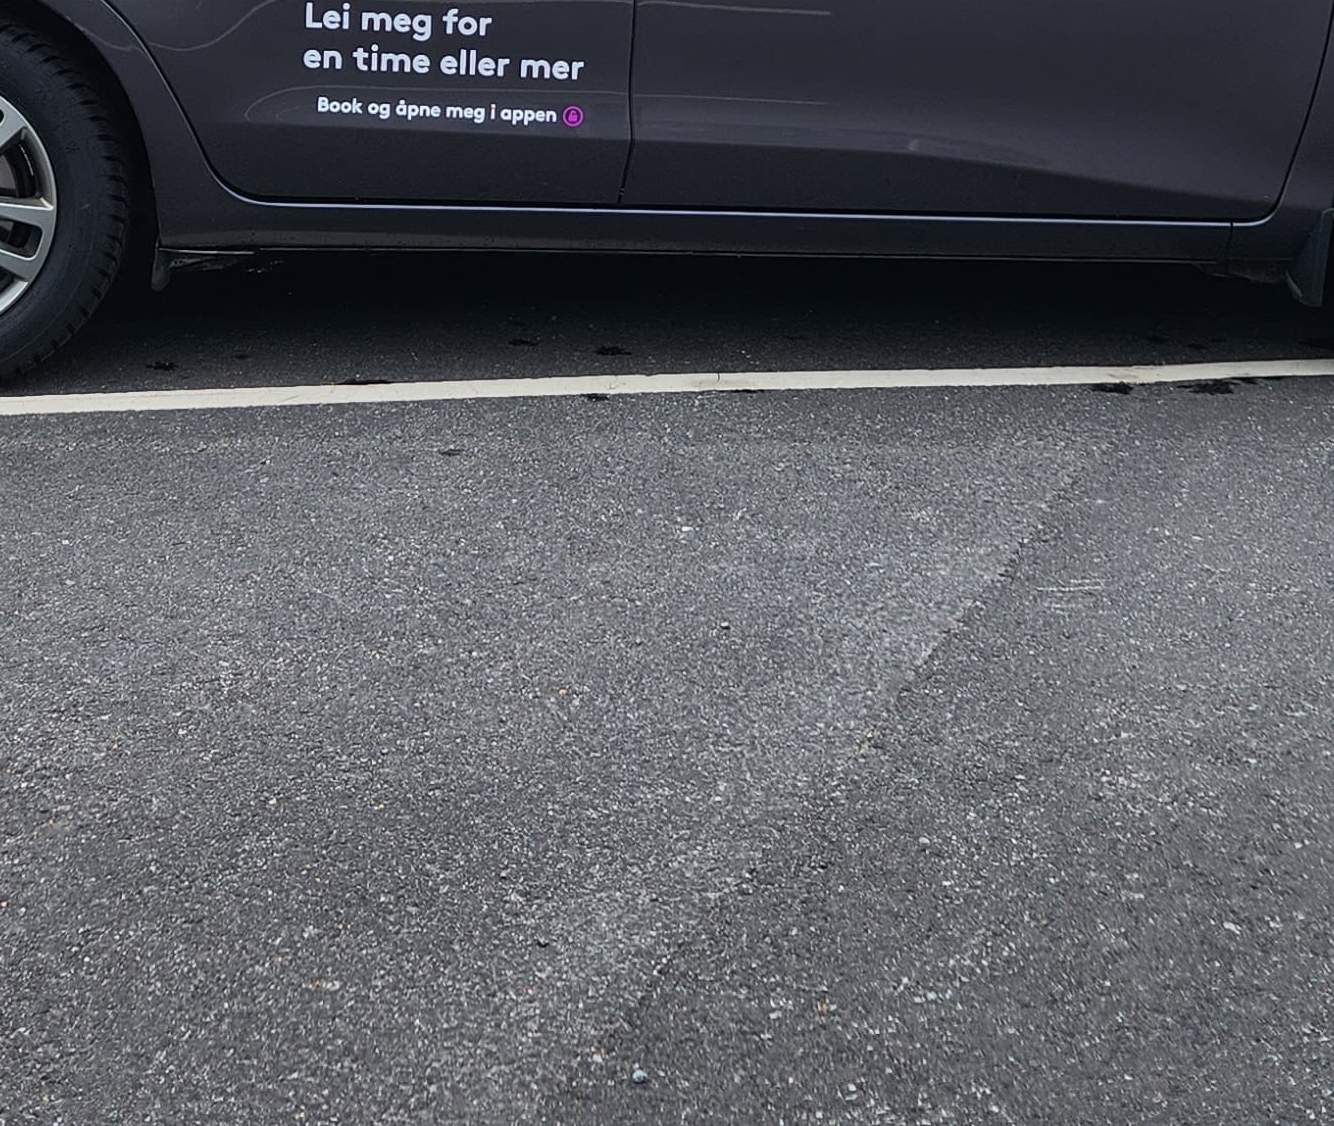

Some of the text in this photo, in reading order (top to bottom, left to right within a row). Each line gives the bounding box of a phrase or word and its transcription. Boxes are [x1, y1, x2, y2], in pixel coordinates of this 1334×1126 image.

[304, 2, 492, 41] Lei meg for
[302, 44, 585, 81] en time eller mer
[317, 96, 557, 126] Book og åpne meg i appen
